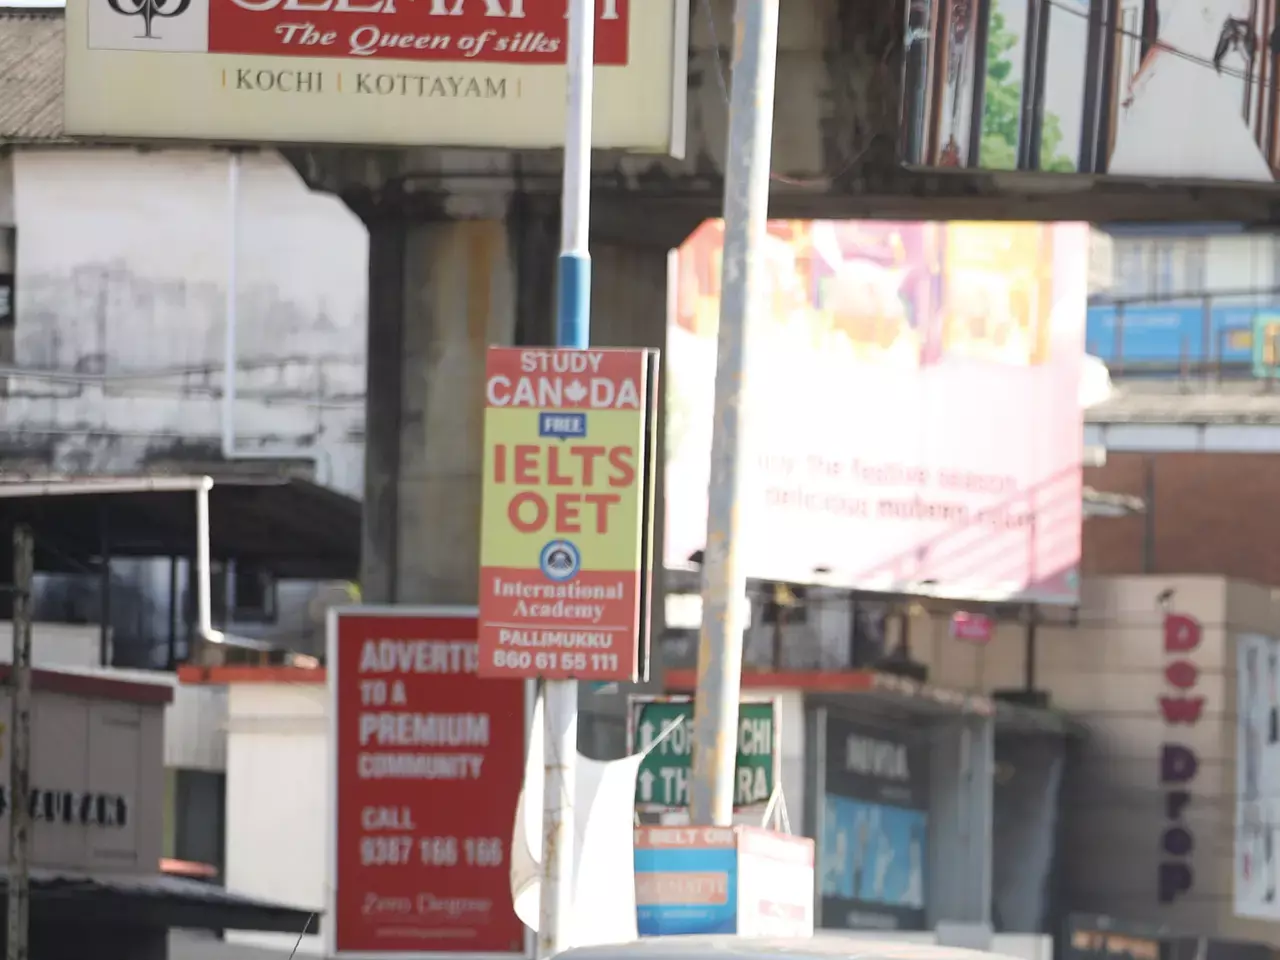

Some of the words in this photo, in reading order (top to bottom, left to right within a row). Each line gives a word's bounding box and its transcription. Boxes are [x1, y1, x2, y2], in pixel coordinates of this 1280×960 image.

[275, 22, 337, 46] The
[348, 25, 450, 56] Queen
[457, 30, 497, 57] of
[497, 29, 561, 53] silks
[235, 68, 323, 93] KOCHI
[356, 73, 507, 99] KOTTAYAM
[520, 351, 603, 374] STUDY
[493, 444, 635, 488] IELTS
[507, 490, 621, 534] OET
[493, 578, 624, 600] International
[513, 600, 604, 624] Academy
[499, 628, 613, 648] PALLIMUKKU
[535, 652, 557, 670] 61
[592, 653, 618, 672] 111
[361, 680, 384, 705] TO
[391, 680, 407, 706] A
[359, 712, 489, 747] PREMIUM
[740, 718, 771, 756] CHI
[358, 753, 484, 779] COMMUNITY
[361, 806, 415, 831] CALL
